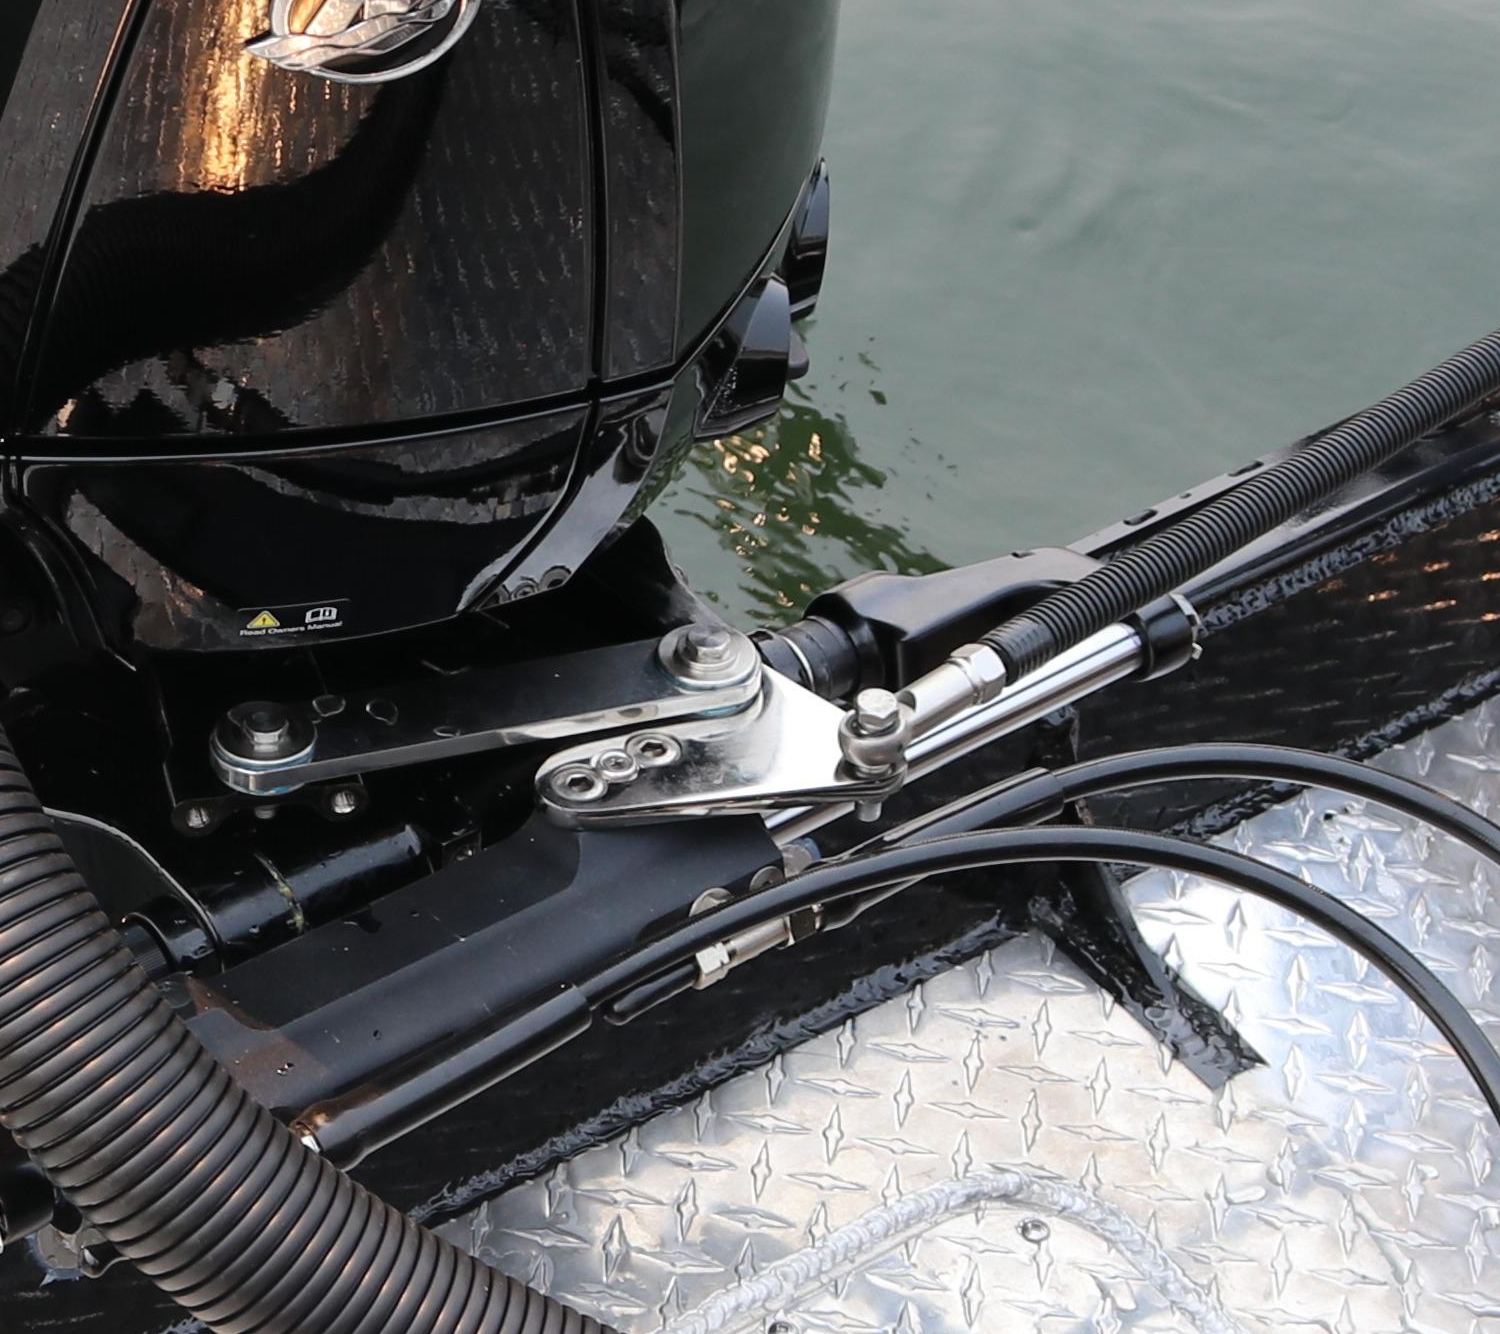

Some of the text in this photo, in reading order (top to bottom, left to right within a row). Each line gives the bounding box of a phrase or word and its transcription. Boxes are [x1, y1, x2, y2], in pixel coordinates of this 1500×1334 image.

[239, 621, 343, 636] Read Owners Manual
